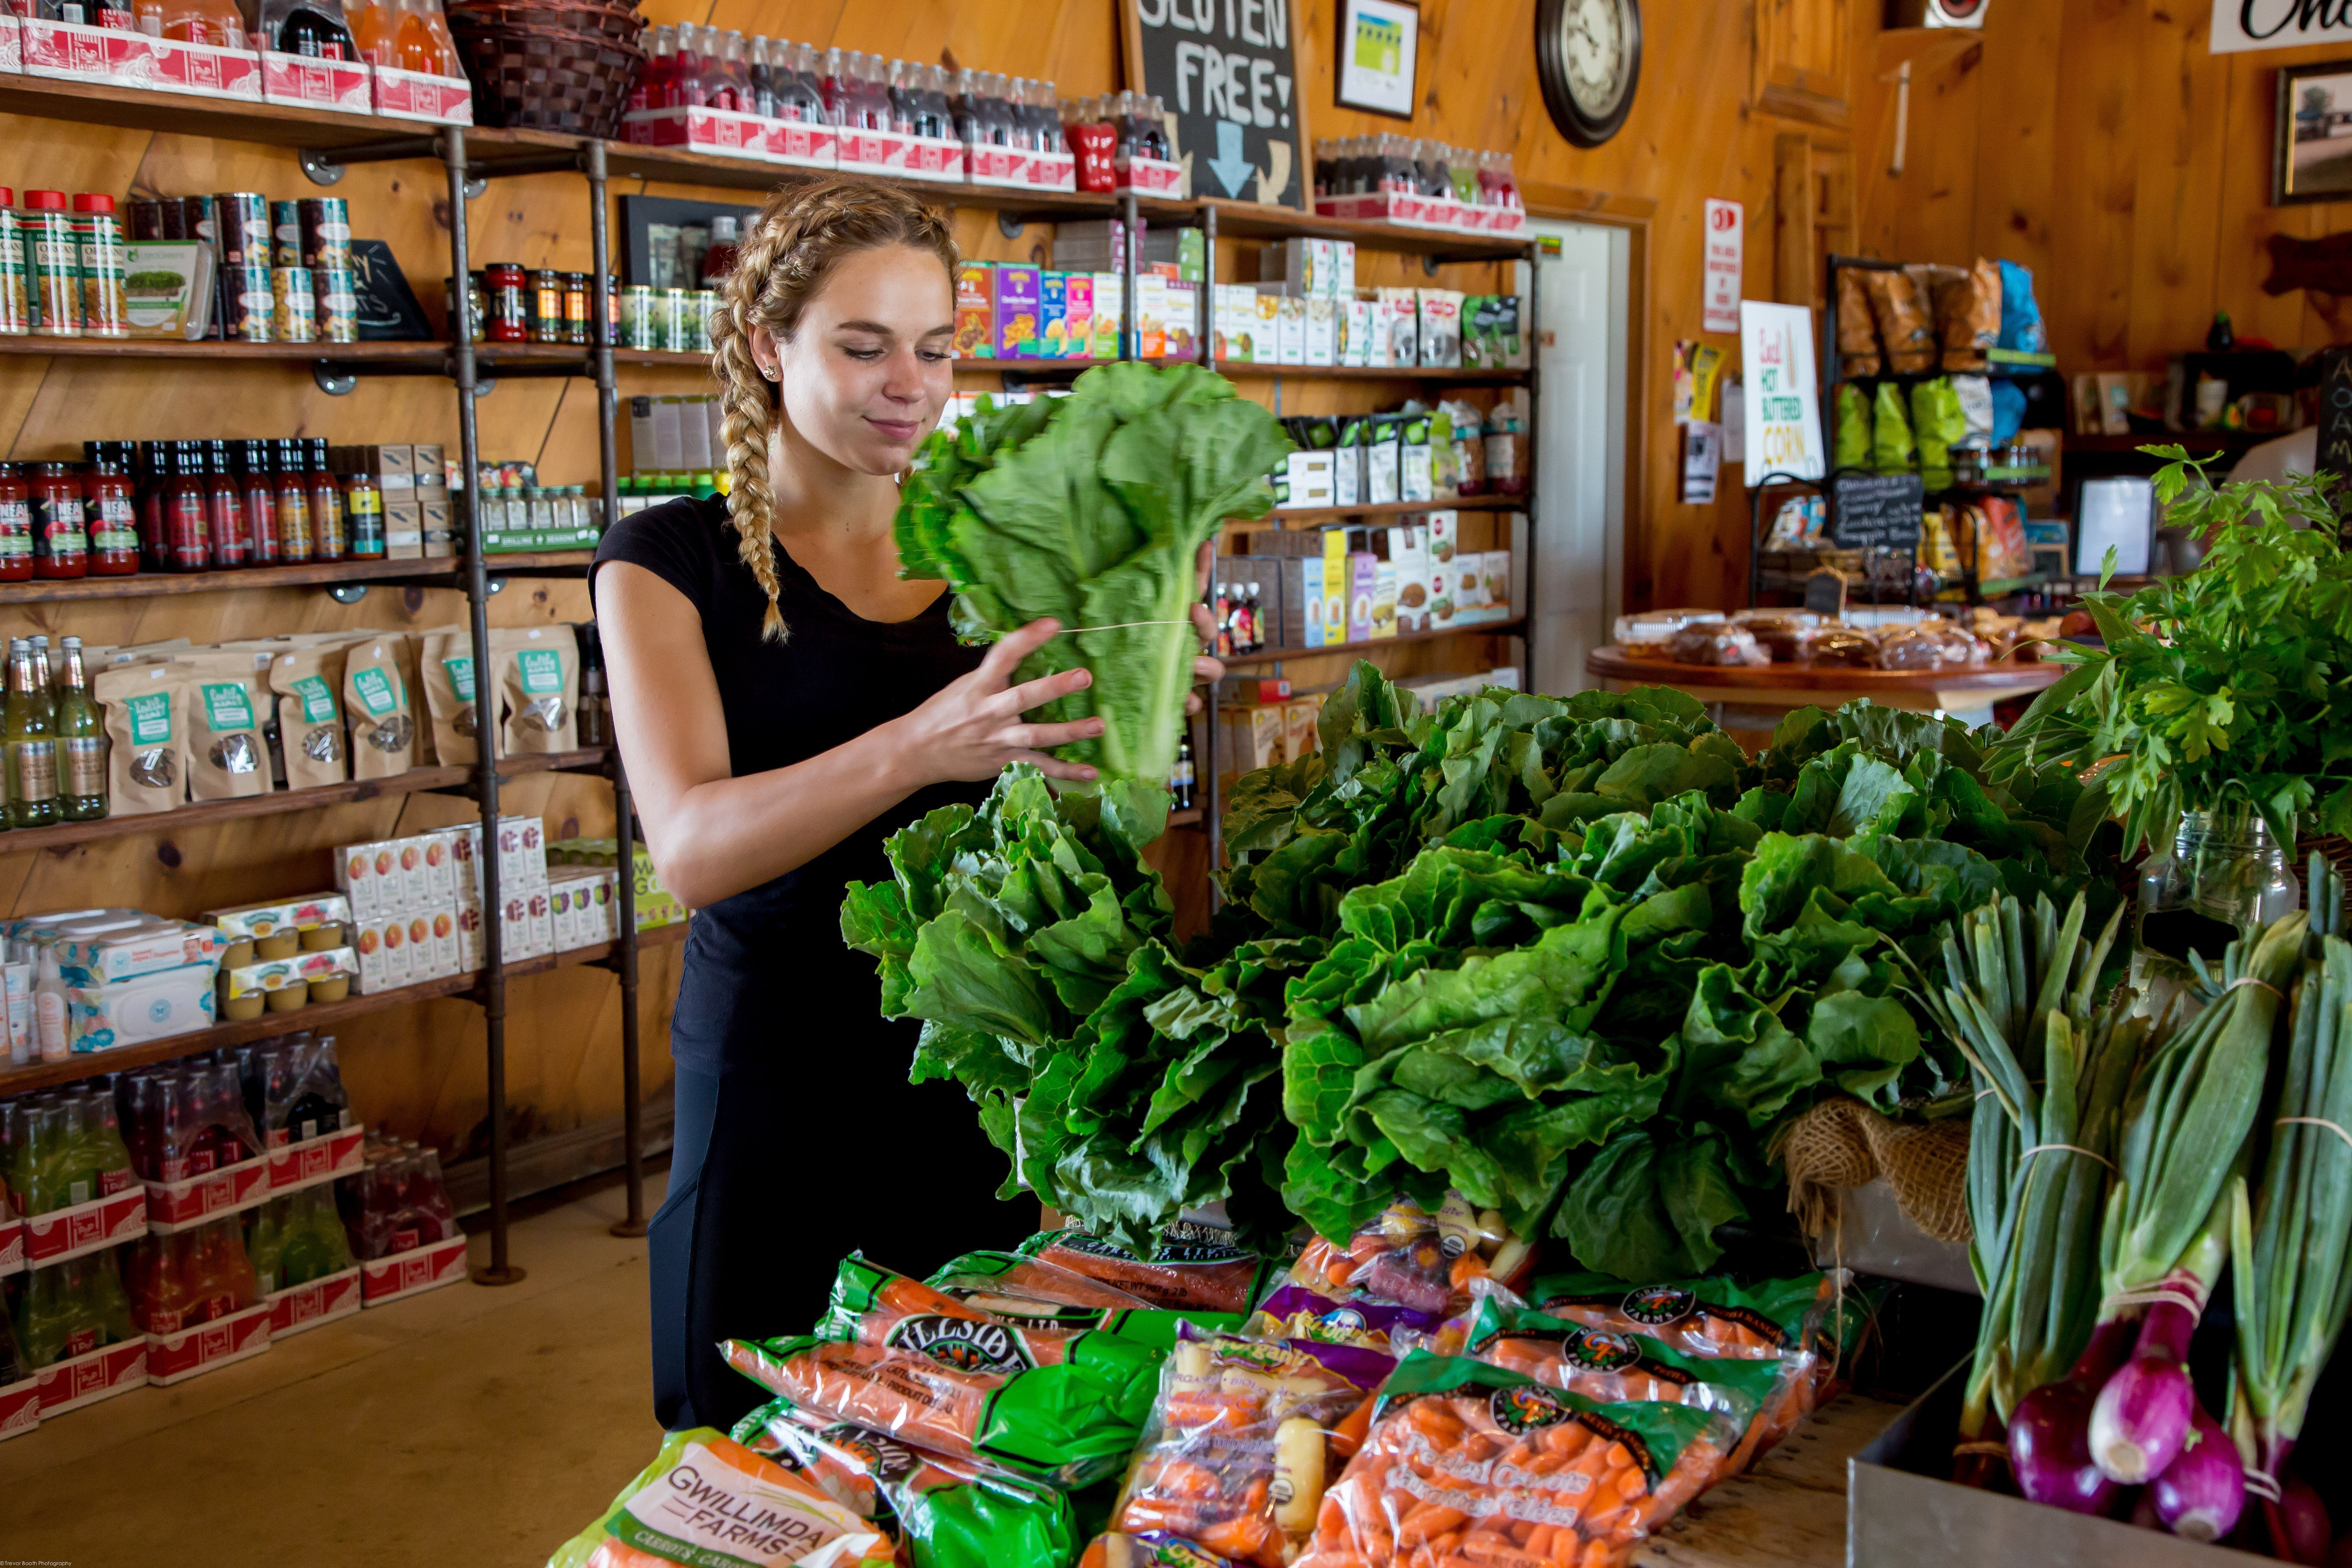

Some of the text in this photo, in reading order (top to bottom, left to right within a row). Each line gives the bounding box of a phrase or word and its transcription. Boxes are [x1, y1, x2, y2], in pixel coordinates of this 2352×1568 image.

[1176, 41, 1292, 128] FREE!
[1086, 1241, 1171, 1262] GARS
[1404, 1430, 1493, 1484] Peeled
[686, 1509, 790, 1556] FARMS
